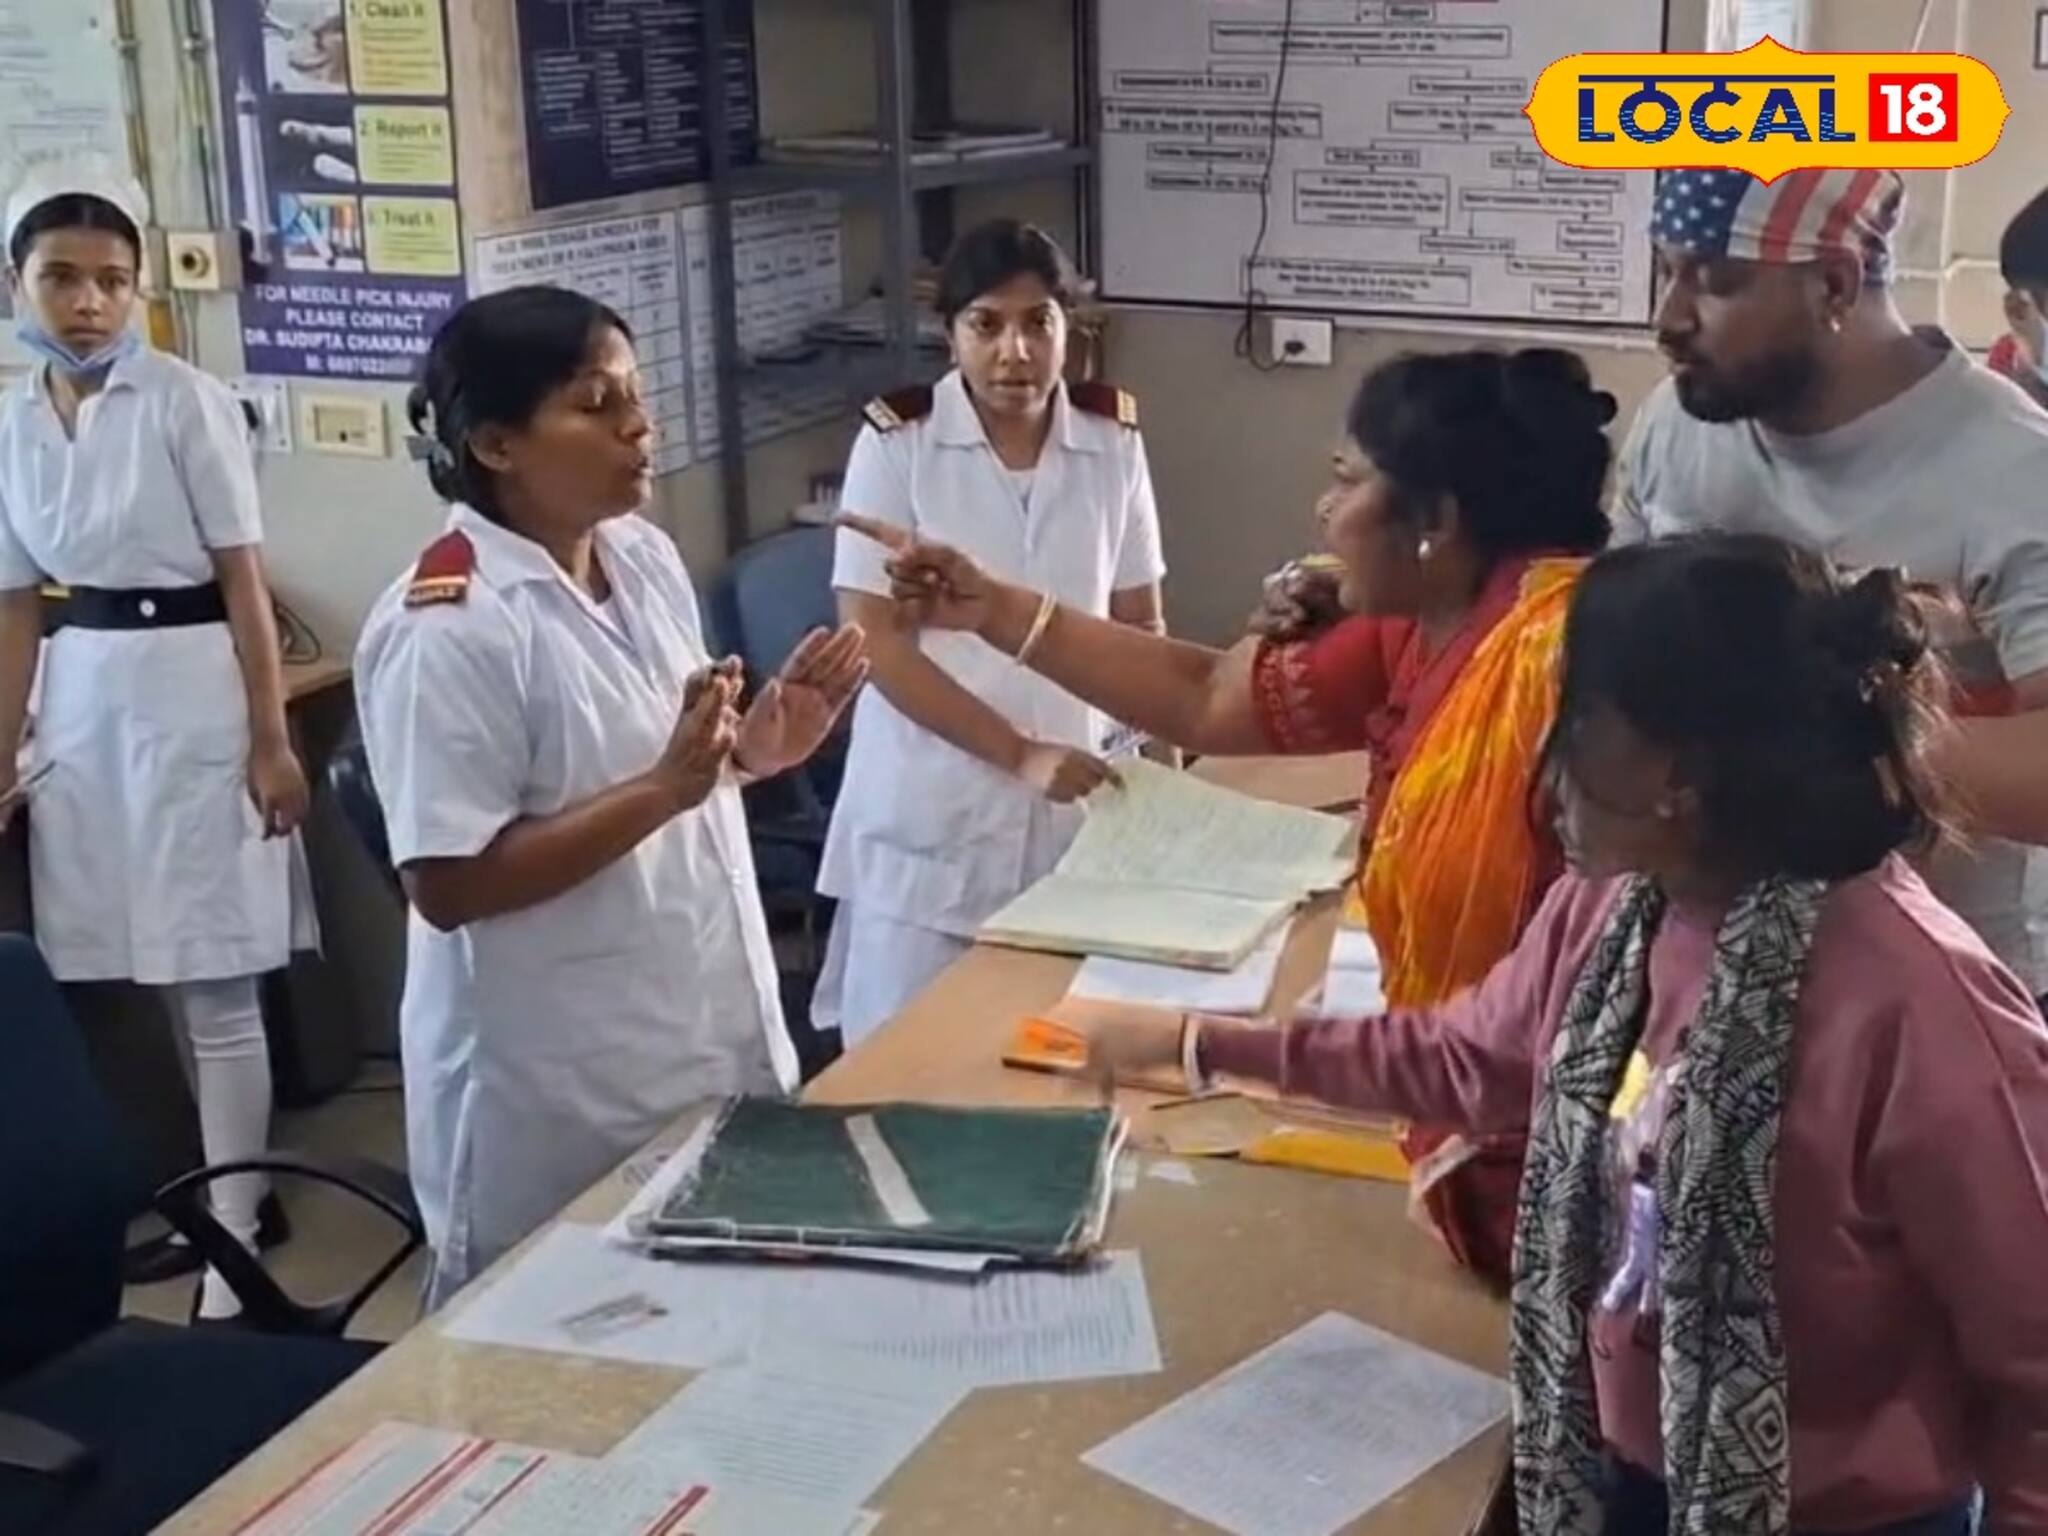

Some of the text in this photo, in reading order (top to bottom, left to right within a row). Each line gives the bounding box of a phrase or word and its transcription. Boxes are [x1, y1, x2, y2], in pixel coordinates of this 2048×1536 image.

[366, 2, 411, 18] Clean
[376, 118, 428, 138] Report
[255, 286, 287, 301] FOR
[290, 286, 350, 305] NEEDLE
[395, 291, 452, 310] INJURY
[285, 307, 424, 332] PLEASE CONTACT
